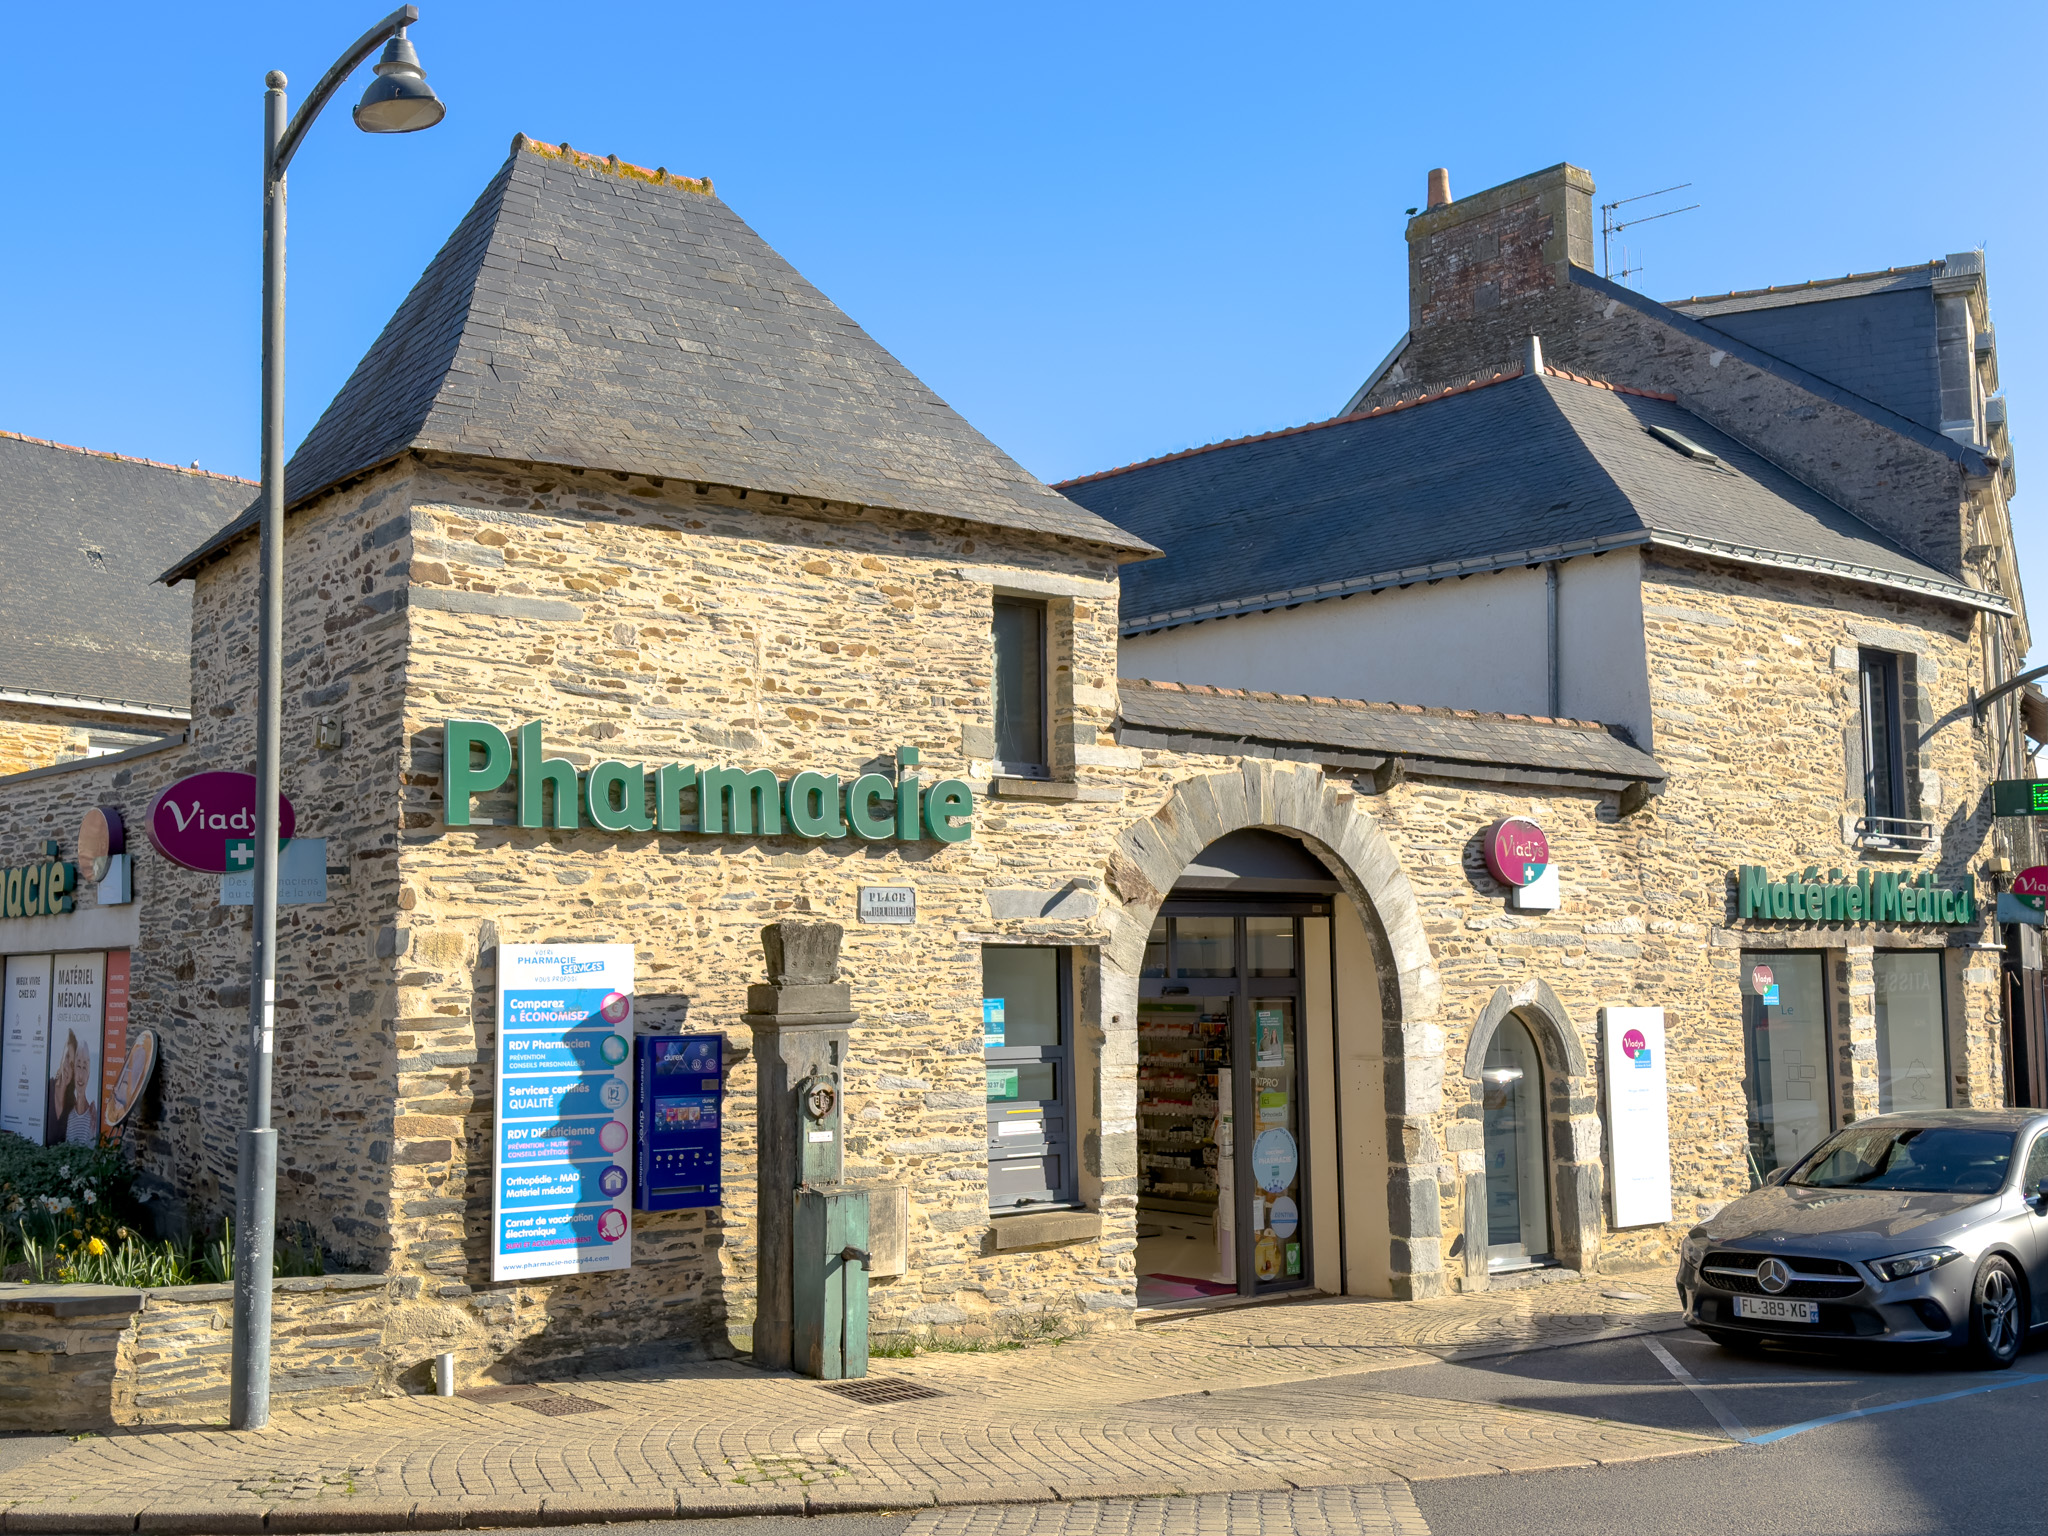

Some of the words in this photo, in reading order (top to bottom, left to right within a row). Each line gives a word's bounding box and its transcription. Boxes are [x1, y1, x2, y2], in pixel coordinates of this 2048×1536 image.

[443, 718, 973, 844] Pharmacie
[1499, 835, 1545, 862] Viadys
[228, 877, 247, 887] Des
[869, 892, 906, 902] PLACE
[1739, 865, 1871, 921] Matériel
[1873, 868, 1975, 924] Médical
[517, 956, 577, 964] PHARMACIE
[562, 962, 603, 974] SERVICES
[58, 965, 94, 985] MATÉRIEL
[1753, 972, 1772, 984] Viadys
[57, 988, 92, 1008] MÉDICAL
[510, 998, 565, 1011] Comparez
[1781, 1004, 1794, 1016] Le
[519, 1010, 590, 1022] ÉCONOMISEZ
[508, 1040, 530, 1050] RDV
[532, 1039, 591, 1050] Pharmacien
[1623, 1037, 1644, 1049] Viadys
[539, 1059, 585, 1068] PERSONNALISÉS
[664, 1053, 684, 1062] durex
[509, 1085, 550, 1096] Services
[551, 1083, 590, 1094] certifiés
[509, 1095, 554, 1110] QUALITÉ
[507, 1129, 529, 1139] RDV
[531, 1126, 595, 1138] Diététicienne
[507, 1141, 545, 1150] PRÉVENTION
[550, 1140, 582, 1148] NUTRITION
[506, 1174, 552, 1187] Orthopédie
[560, 1173, 580, 1182] MAD
[506, 1186, 540, 1198] Matériel
[542, 1185, 574, 1196] médical
[505, 1217, 534, 1228] Carnet
[535, 1216, 546, 1226] de
[548, 1213, 594, 1224] vaccination
[505, 1227, 556, 1239] électronique
[532, 1236, 592, 1248] ACCOMPAGNEMENT
[503, 1255, 610, 1270] www.pharmacie-nozay44.com
[1741, 1299, 1807, 1318] FL-389-XG
